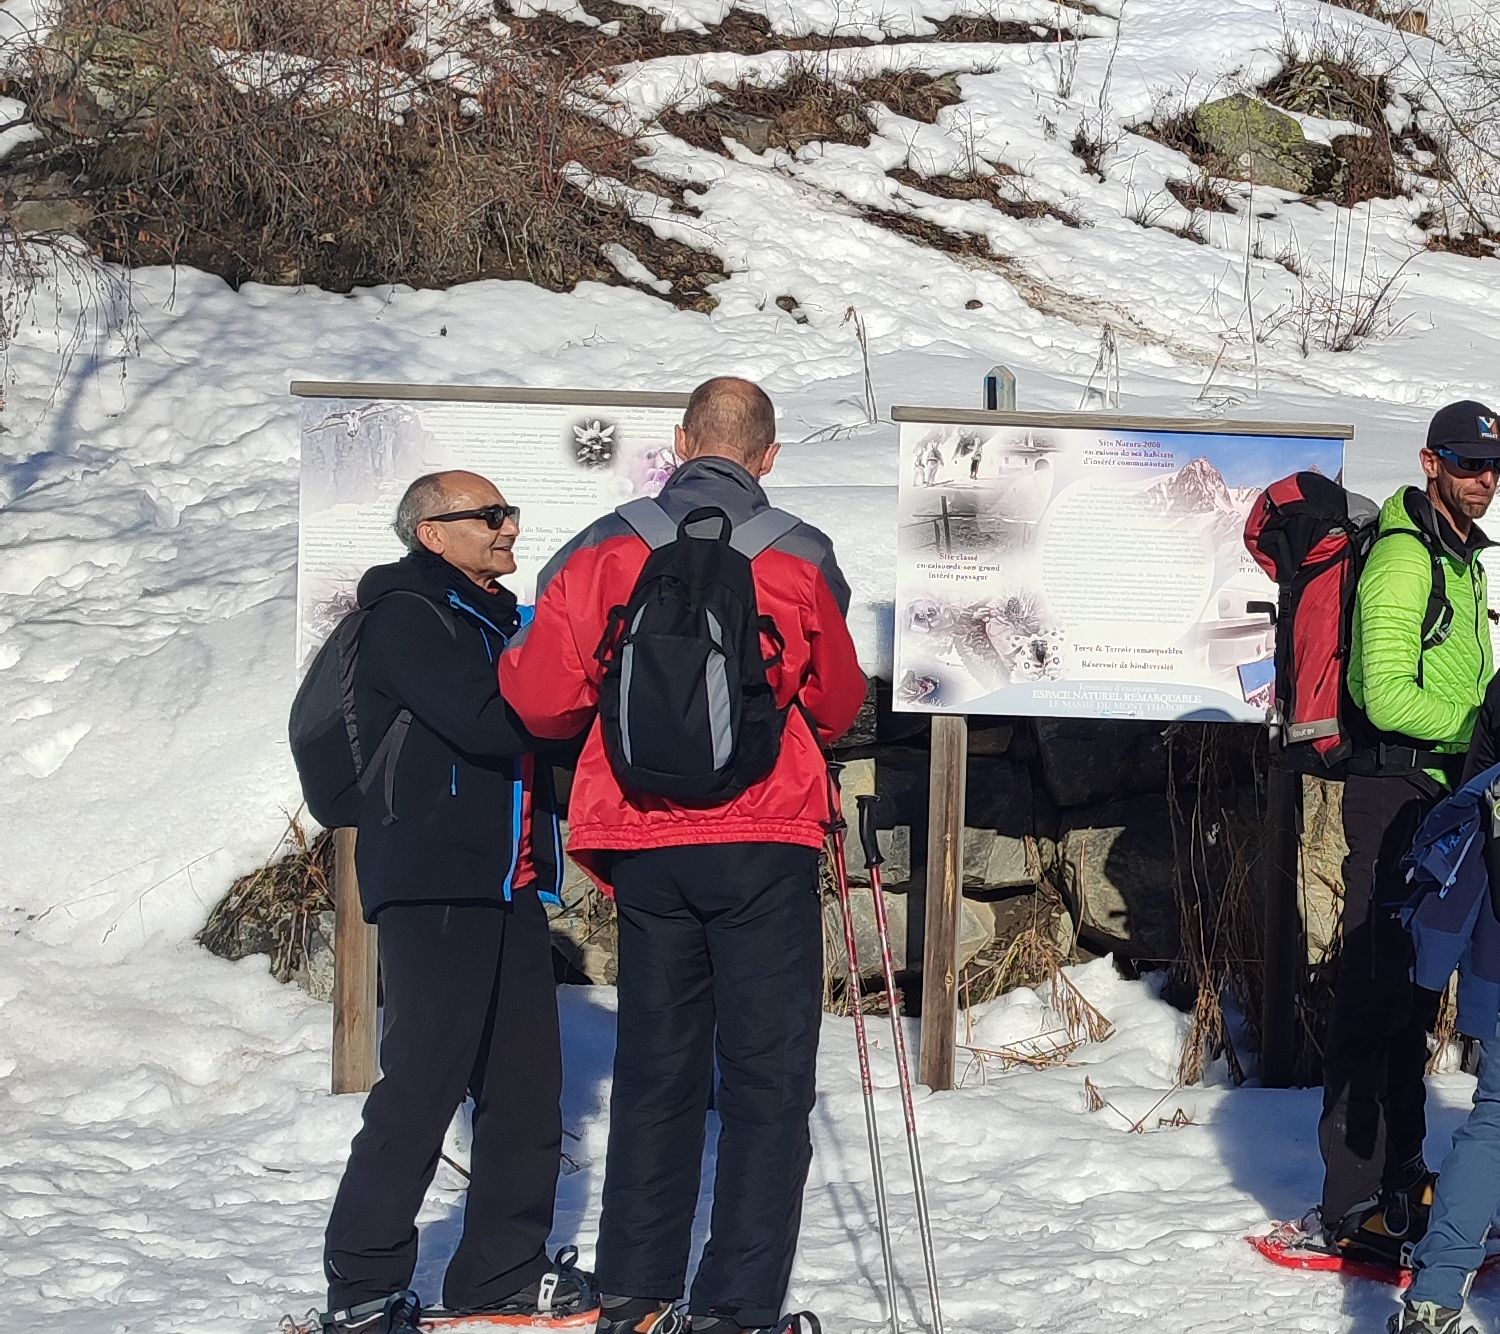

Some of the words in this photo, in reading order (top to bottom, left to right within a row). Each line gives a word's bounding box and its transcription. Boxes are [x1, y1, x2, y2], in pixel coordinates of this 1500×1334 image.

[1032, 690, 1072, 699] ESPACE
[1073, 691, 1122, 701] NATUREL
[1124, 693, 1202, 704] REMARQUABLE
[1049, 700, 1062, 708] LE
[1063, 700, 1095, 709] MASSIF
[1097, 701, 1112, 710] DU
[1114, 702, 1143, 711] MONT
[1145, 703, 1185, 712] THABOR
